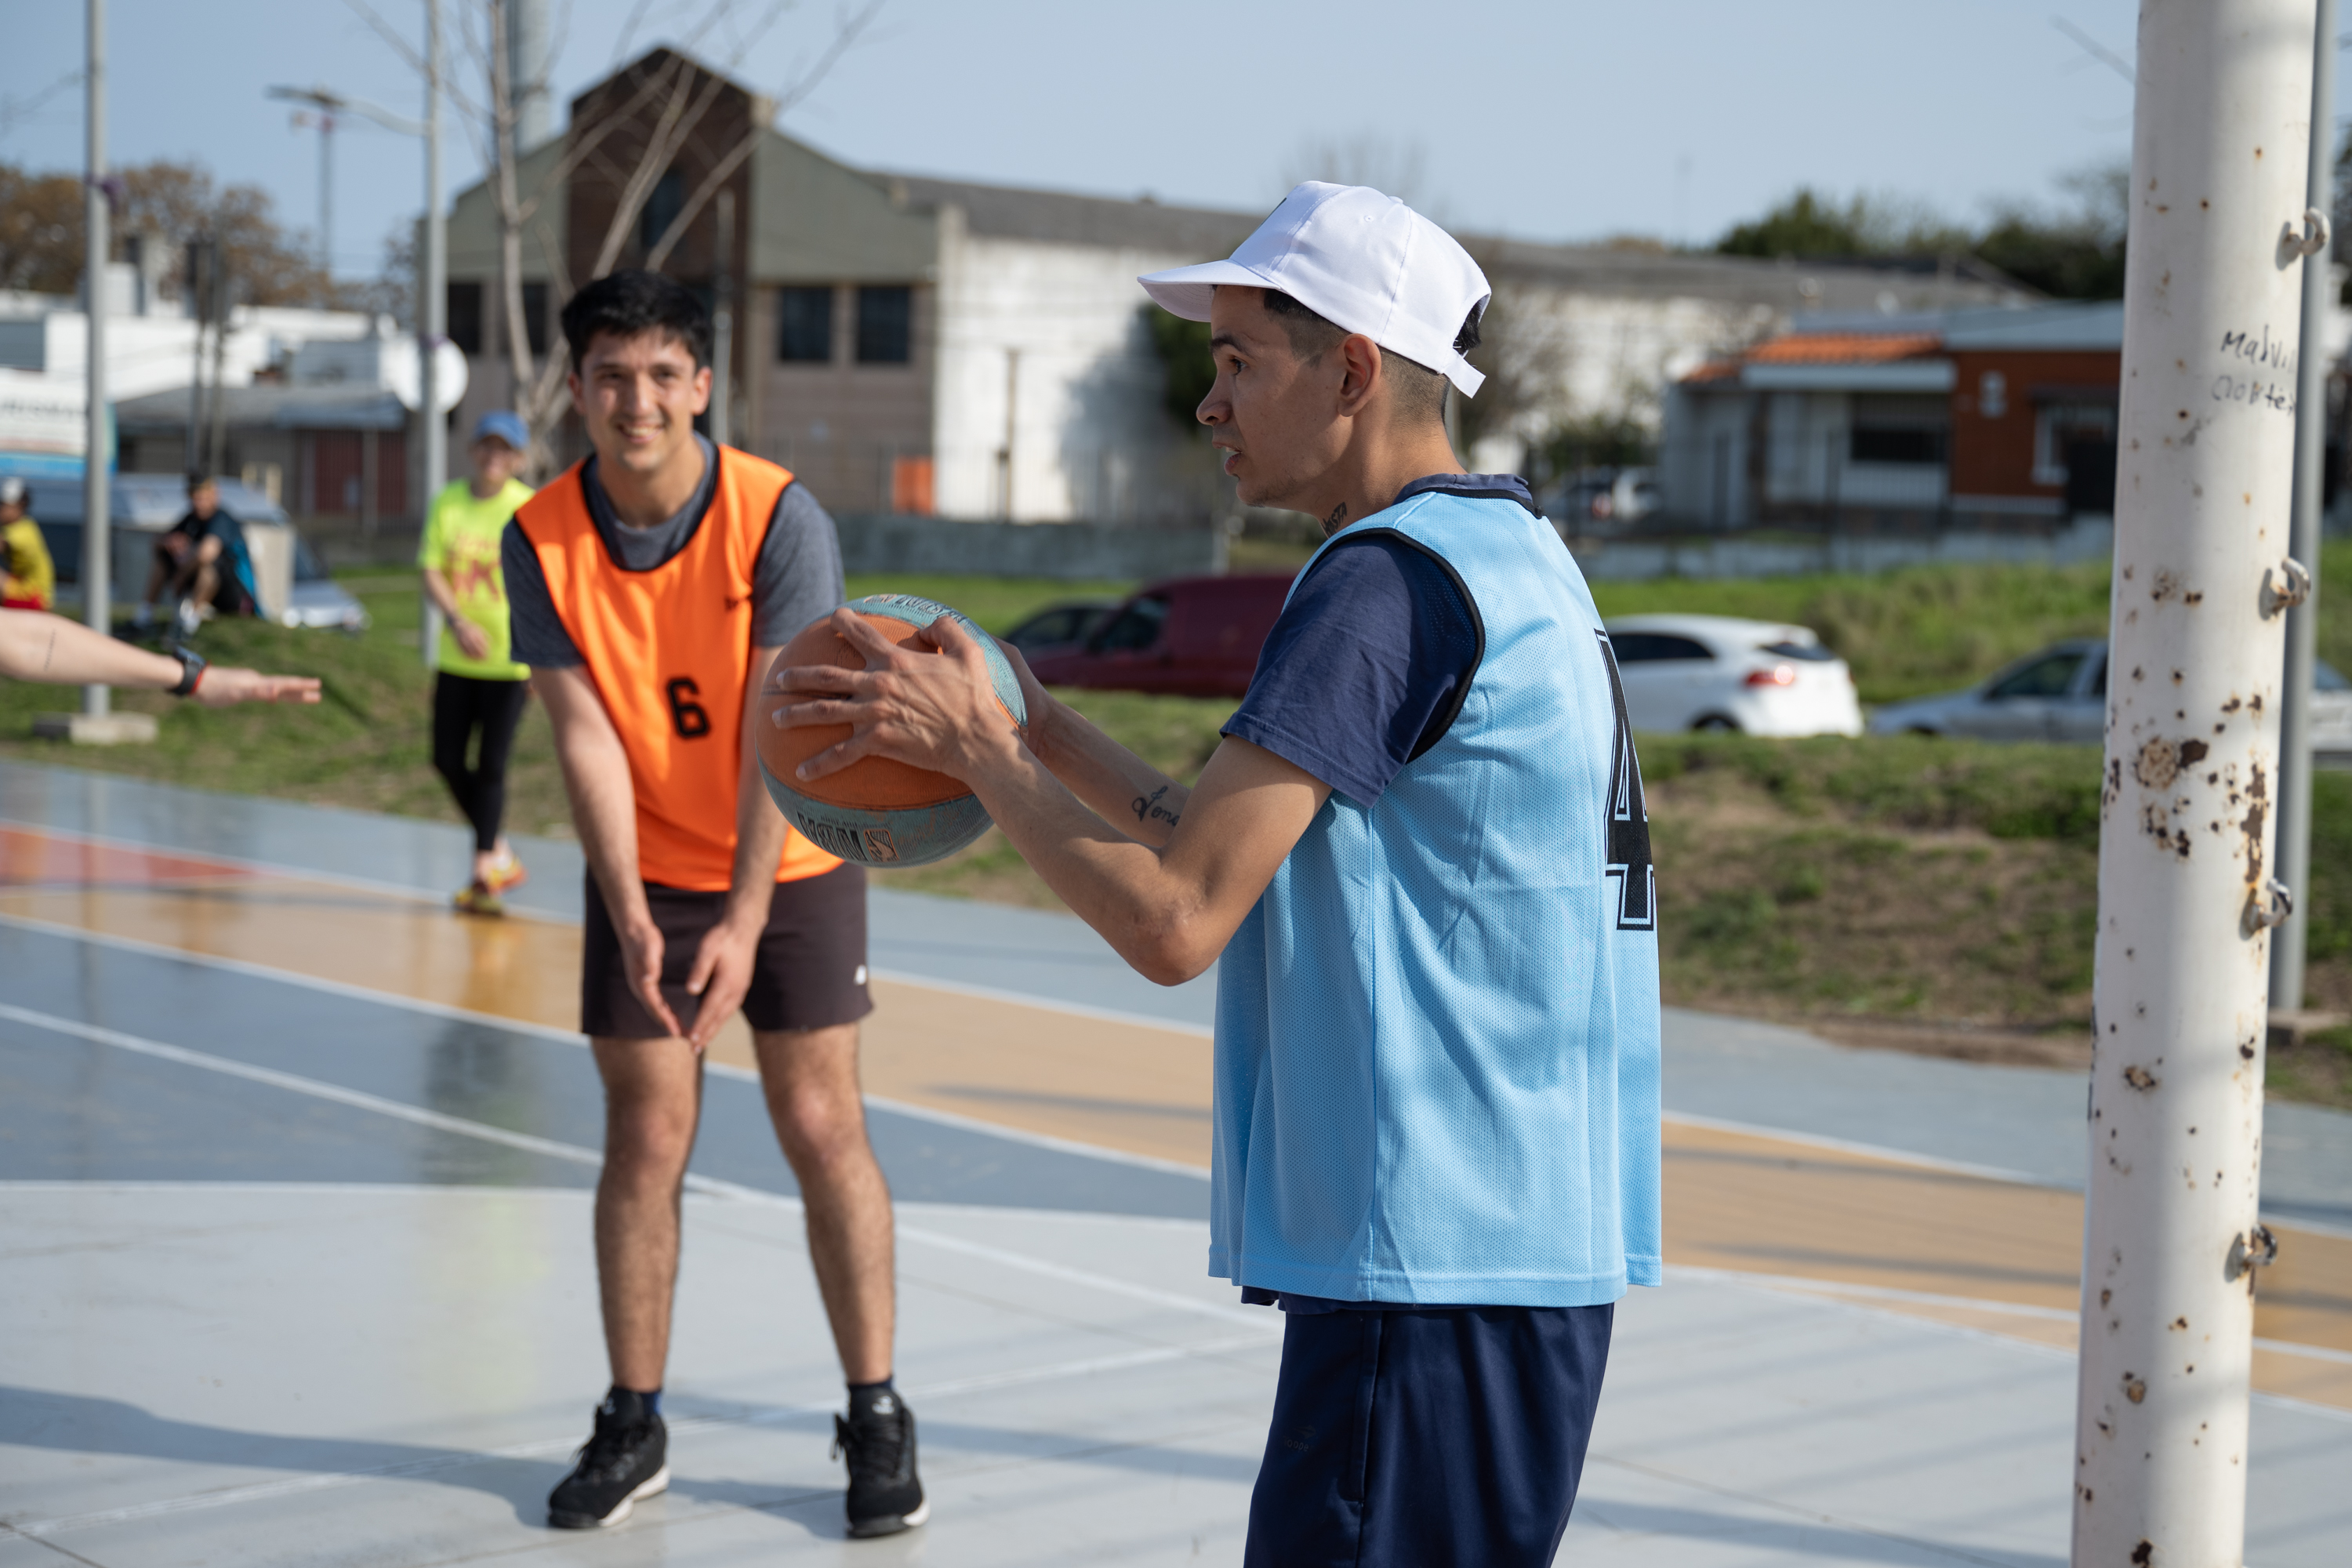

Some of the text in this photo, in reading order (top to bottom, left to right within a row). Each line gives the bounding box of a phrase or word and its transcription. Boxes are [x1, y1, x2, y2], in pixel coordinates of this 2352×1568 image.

[2220, 324, 2297, 373] Malvi
[666, 676, 711, 739] 6
[1594, 628, 1654, 931] 4
[1283, 1436, 1314, 1453] Toppe
